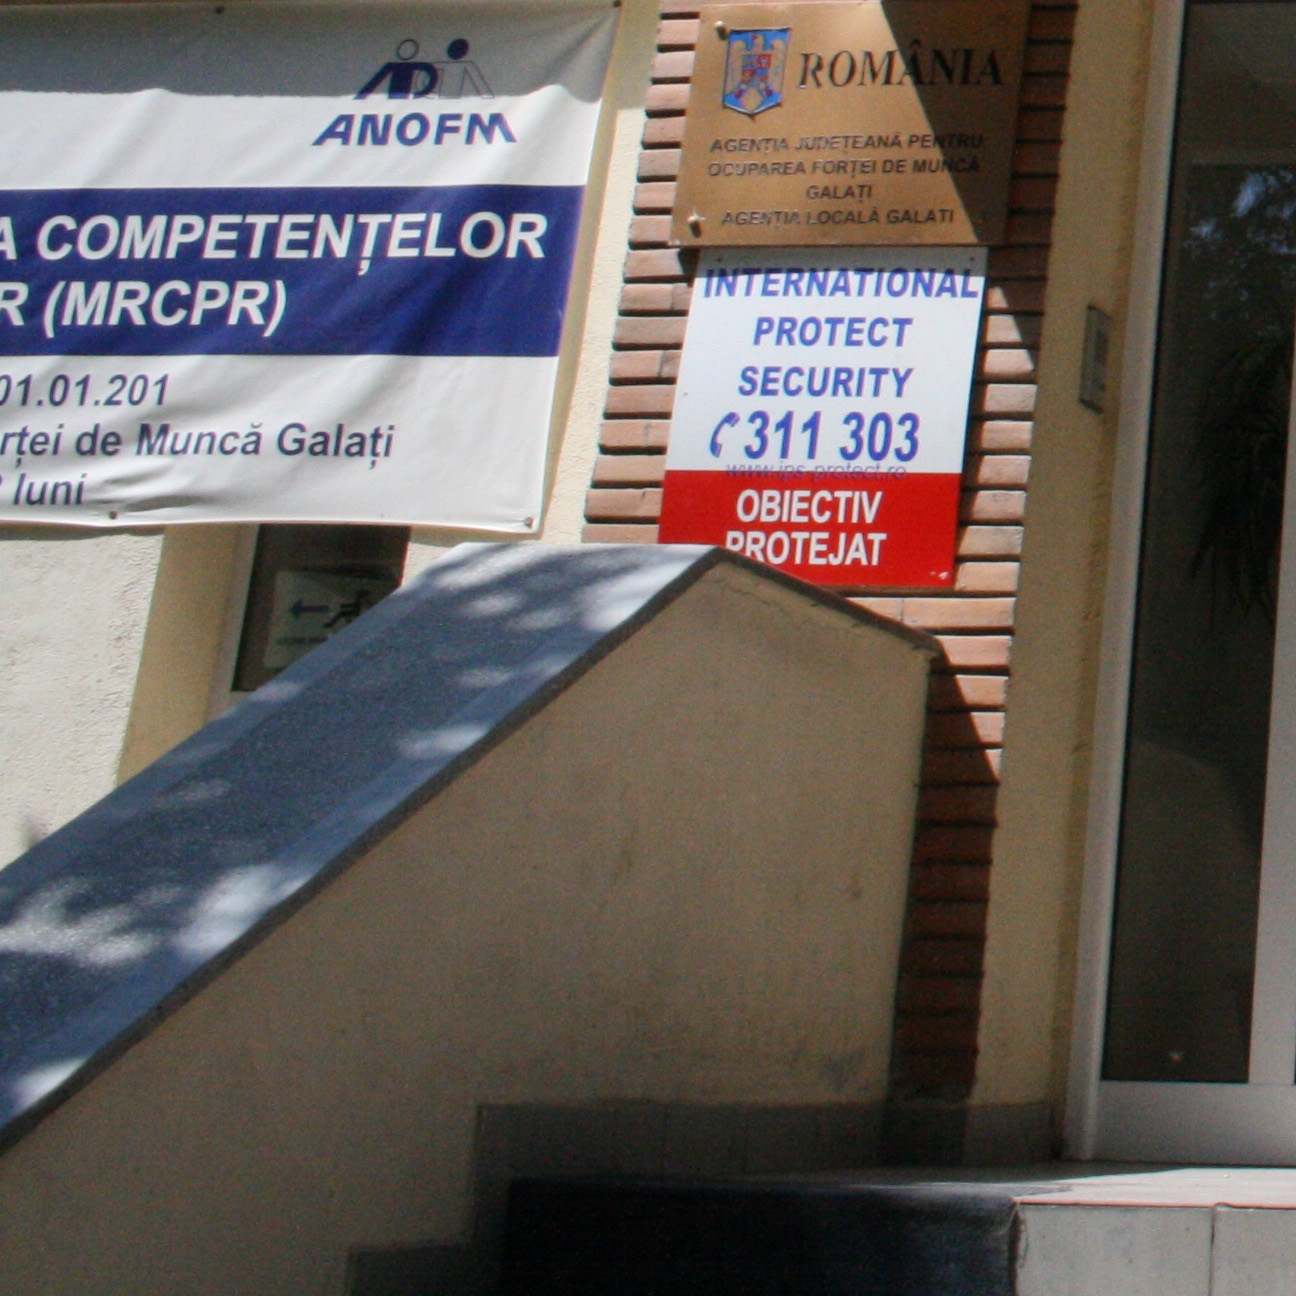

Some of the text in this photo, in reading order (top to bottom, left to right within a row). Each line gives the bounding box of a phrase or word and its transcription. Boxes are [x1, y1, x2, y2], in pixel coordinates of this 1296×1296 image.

[797, 39, 1006, 88] ROMÂNIA
[311, 111, 518, 146] ANOFM
[907, 133, 984, 150] PENTRU
[707, 160, 806, 177] OCUPAREA
[881, 160, 906, 174] DE
[703, 267, 979, 298] INTERNATIONAL
[43, 279, 288, 338] (MRCPR)
[753, 316, 914, 347] PROTECT
[738, 365, 915, 398] SECURITY
[75, 423, 123, 456] de
[136, 420, 263, 458] Muncă
[744, 409, 921, 463] 311 303
[13, 472, 88, 505] luni
[725, 461, 908, 483] www.ips-protect.ro
[735, 487, 884, 524] OBIECTIV
[724, 529, 889, 567] PROTEJAT
